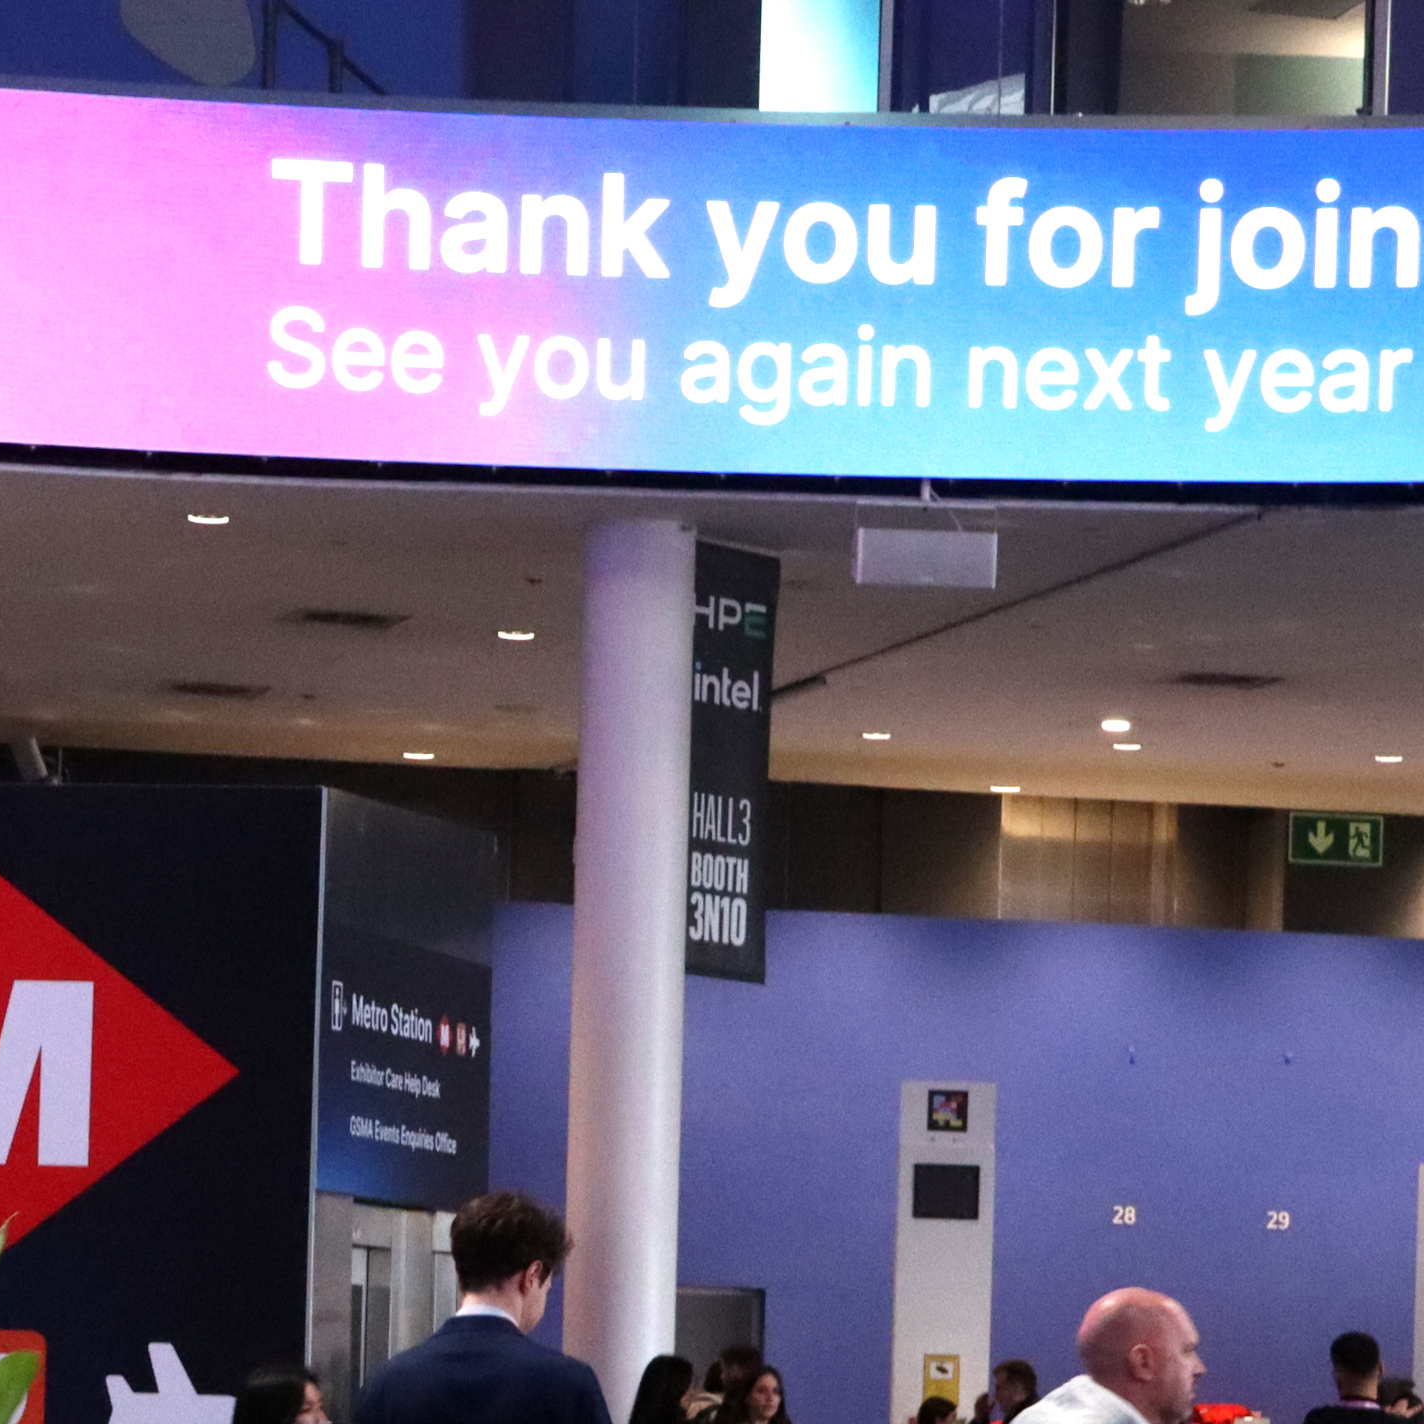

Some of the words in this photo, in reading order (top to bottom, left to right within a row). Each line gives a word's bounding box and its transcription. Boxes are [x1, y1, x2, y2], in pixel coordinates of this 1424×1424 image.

[270, 156, 671, 279] Thank
[706, 199, 937, 308] you
[977, 176, 1160, 288] for
[267, 306, 445, 394] See
[477, 332, 647, 416] you
[679, 323, 932, 426] again
[966, 334, 1172, 412] next
[1203, 345, 1413, 432] year
[693, 594, 768, 639] HPE
[690, 850, 749, 894] BOOTH
[688, 893, 748, 946] 3N10
[352, 993, 388, 1034] Metro
[391, 1002, 433, 1044] Station
[350, 1060, 384, 1087] Exhibitor
[385, 1068, 402, 1091] Care
[404, 1072, 421, 1098] Help
[422, 1075, 441, 1098] Desk
[349, 1115, 374, 1138] GSMA
[374, 1119, 400, 1145] Events
[401, 1124, 434, 1152] Enquiries
[435, 1131, 457, 1154] Office
[1112, 1205, 1137, 1225] 28
[1266, 1211, 1291, 1230] 29
